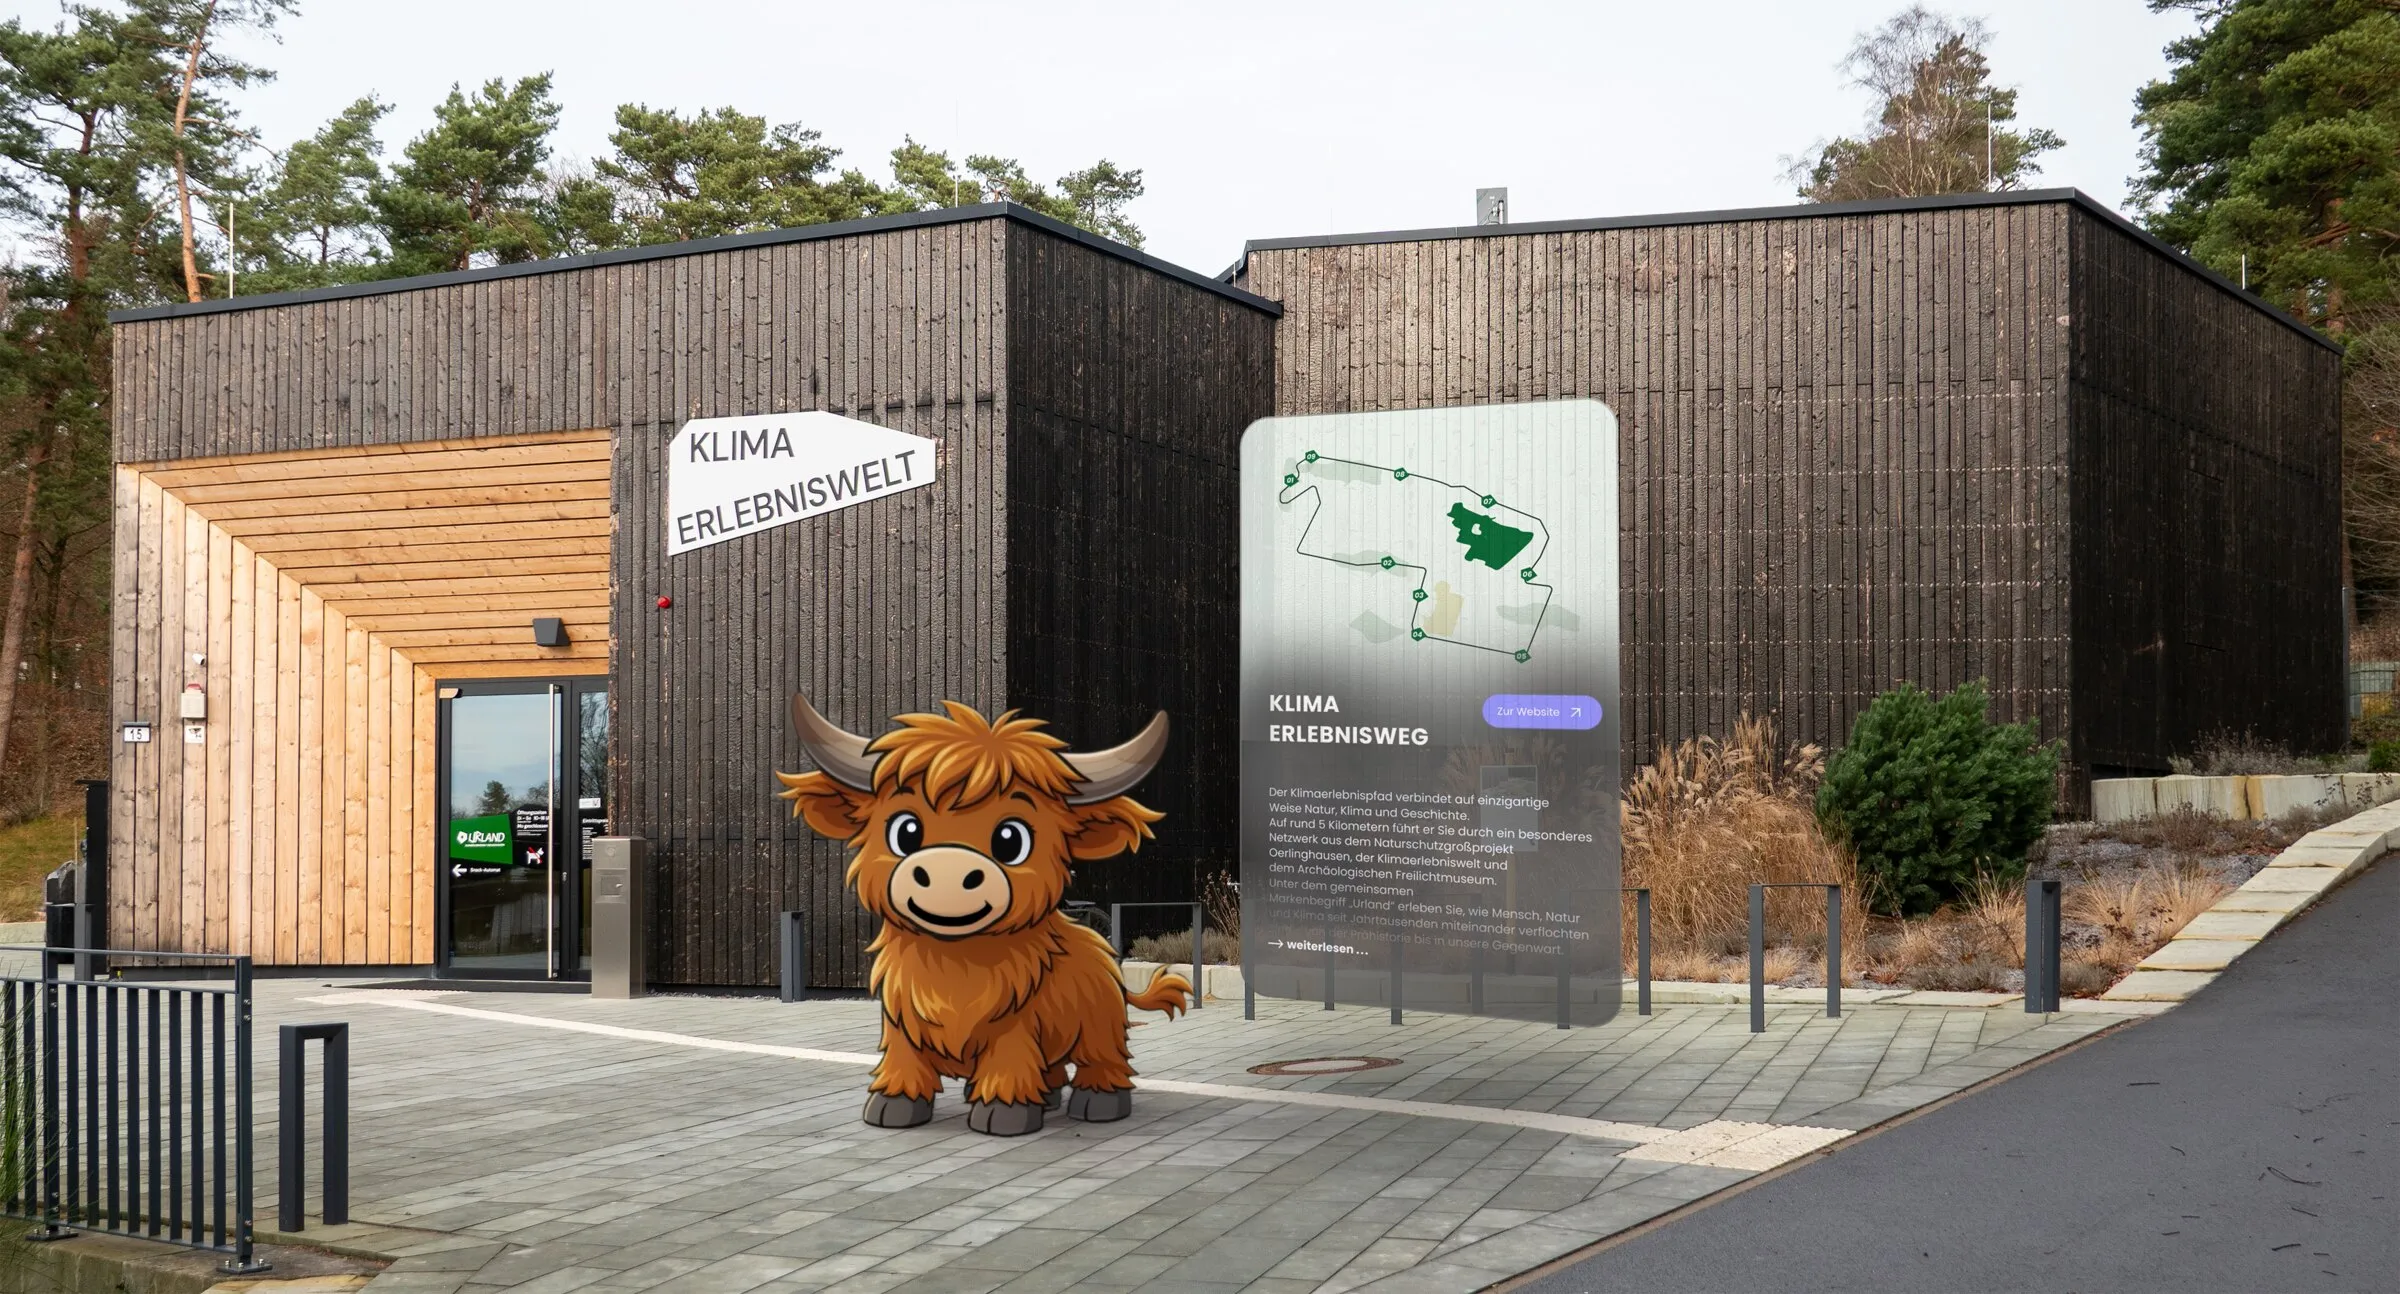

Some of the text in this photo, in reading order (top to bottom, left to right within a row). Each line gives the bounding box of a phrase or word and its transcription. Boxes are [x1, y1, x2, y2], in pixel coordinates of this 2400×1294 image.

[690, 427, 795, 463] KLIMA
[677, 449, 916, 545] ERLEBNISWELT
[130, 728, 142, 740] 15
